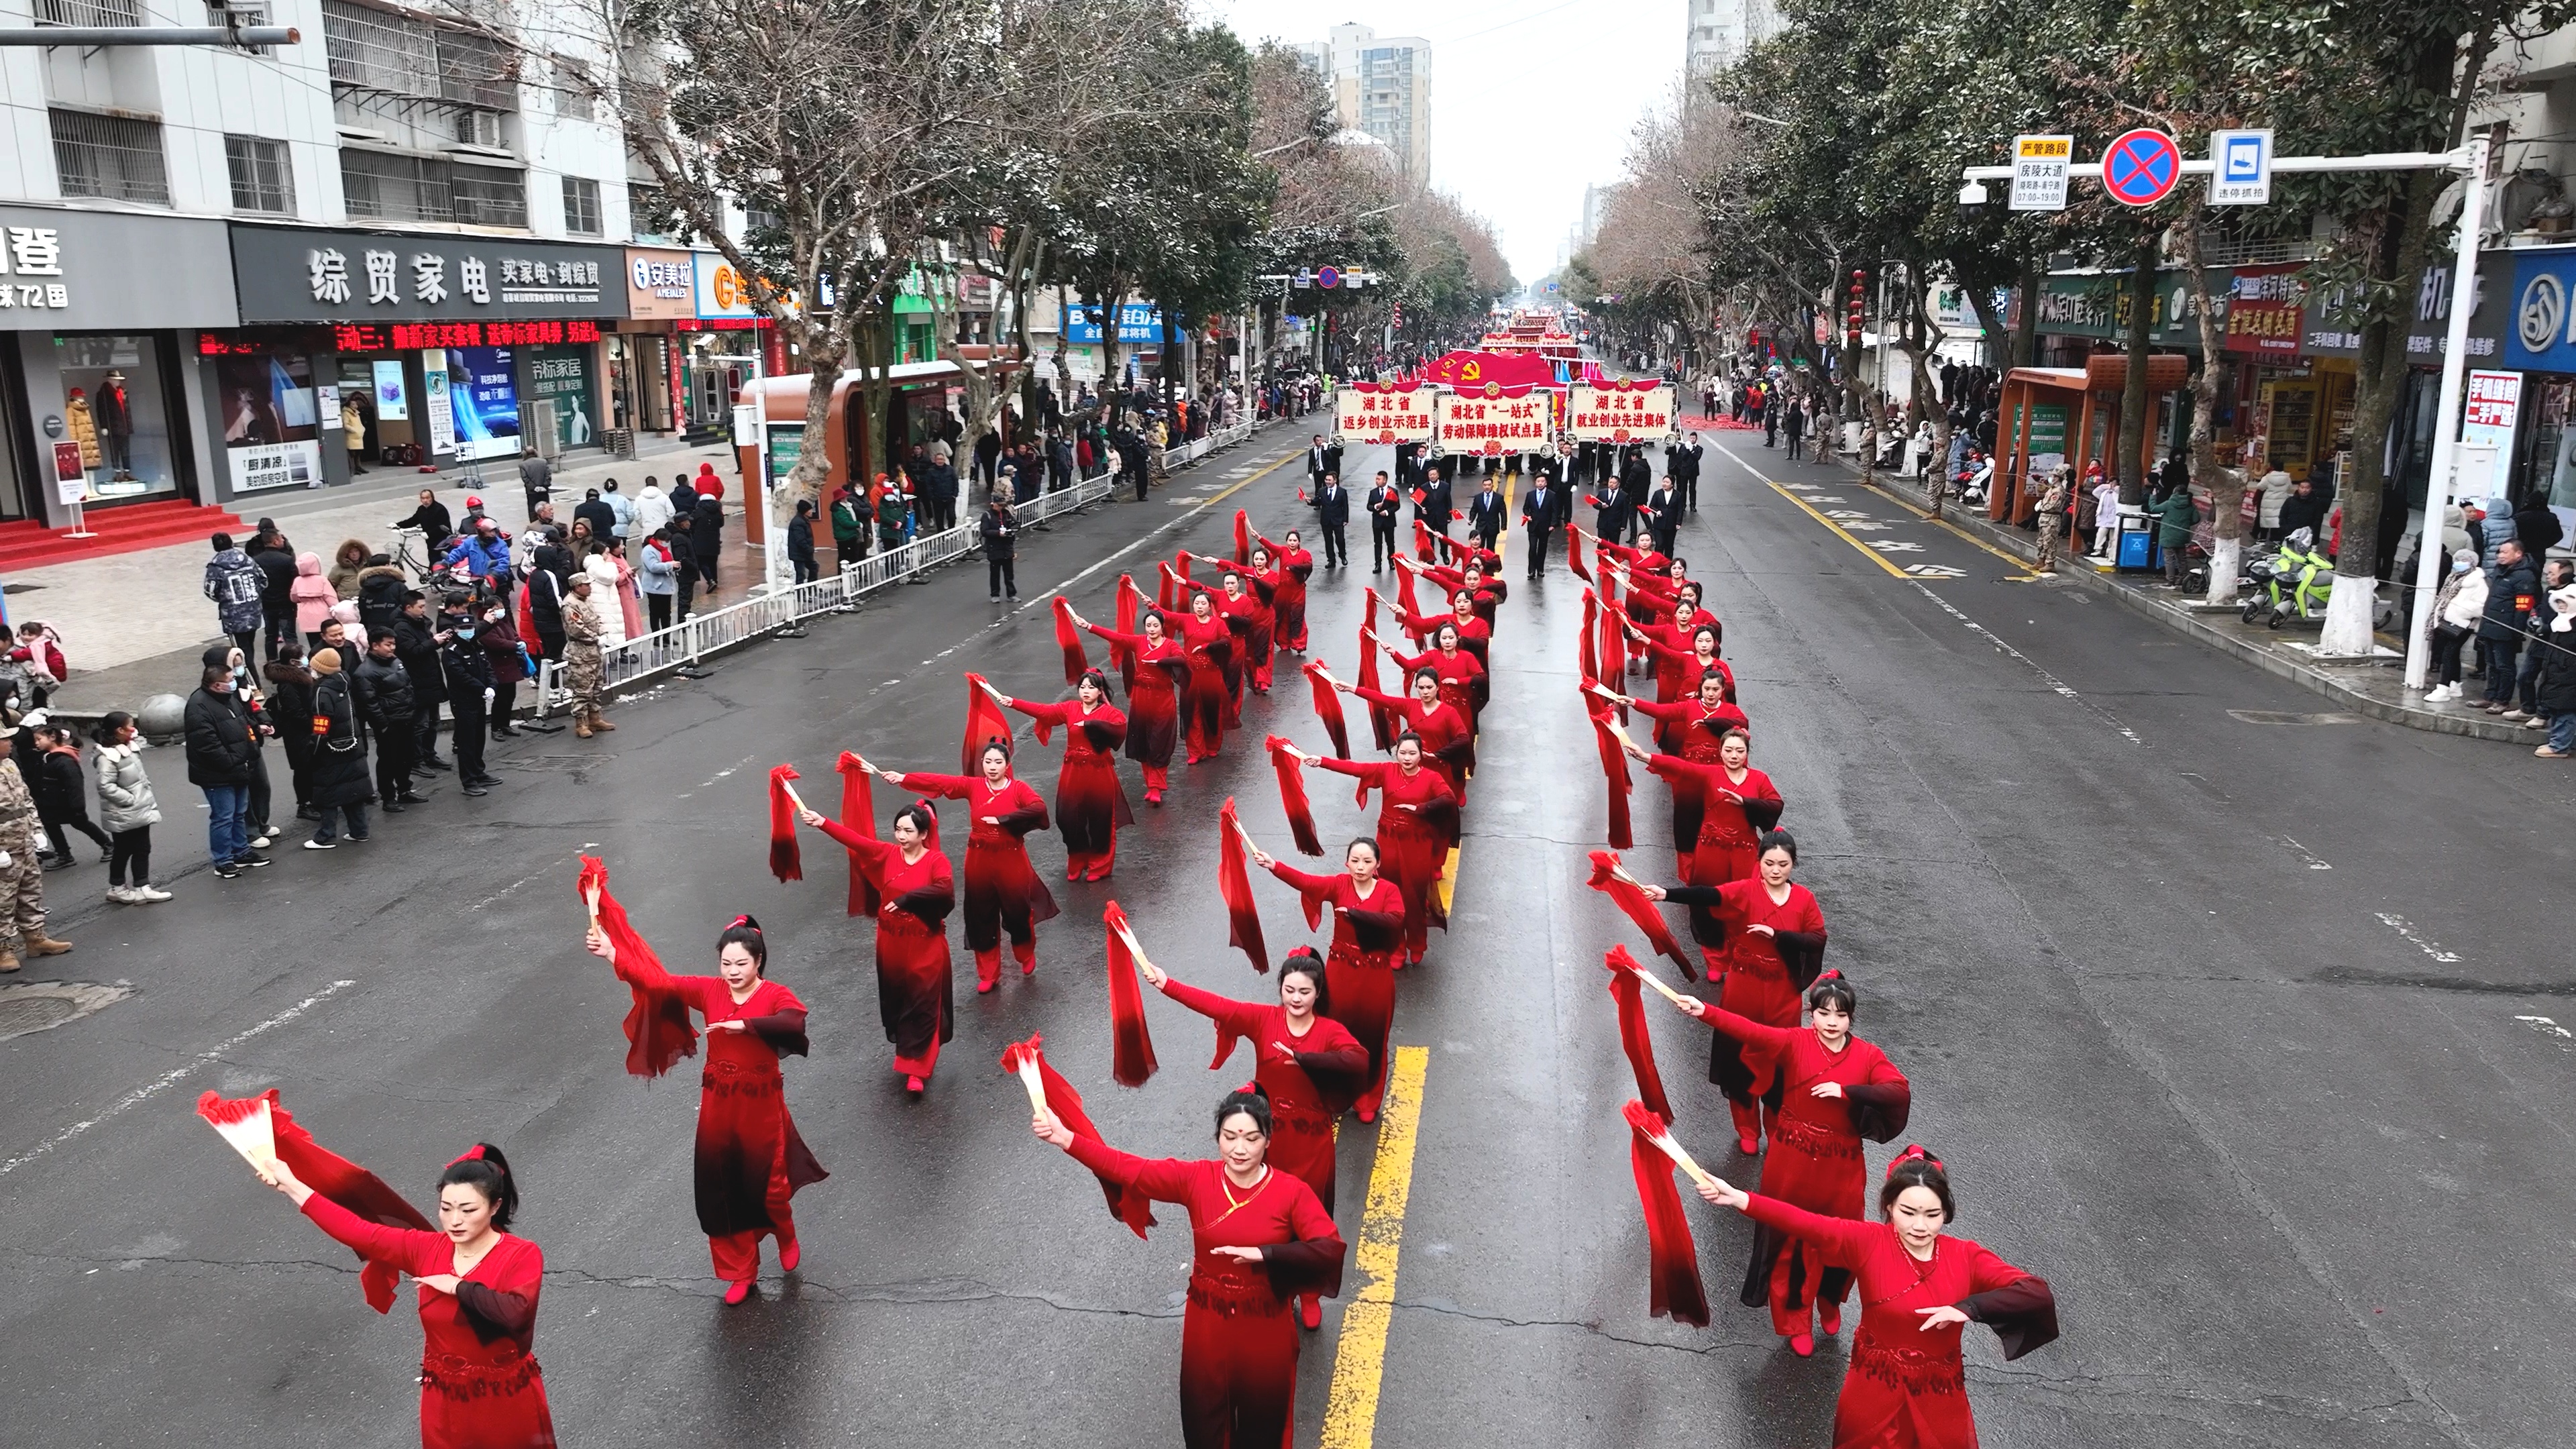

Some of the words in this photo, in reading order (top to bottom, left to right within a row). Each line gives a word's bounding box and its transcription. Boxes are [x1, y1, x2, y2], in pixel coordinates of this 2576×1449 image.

[2021, 143, 2067, 155] 严管路段
[2021, 164, 2063, 177] 房陵大道
[2218, 188, 2263, 198] 违停抓拍
[0, 227, 63, 276] 登
[309, 248, 491, 305] 综贸家电
[651, 262, 691, 286] 安美拉
[1085, 327, 1151, 339] 全自麻将机
[1363, 396, 1410, 411] 湖北省
[1596, 395, 1644, 410] 湖北省
[1344, 415, 1430, 429] 返乡创业示范县
[1576, 413, 1666, 427] 就业创业先进集体
[1443, 423, 1543, 439] 劳动保障维权试点县
